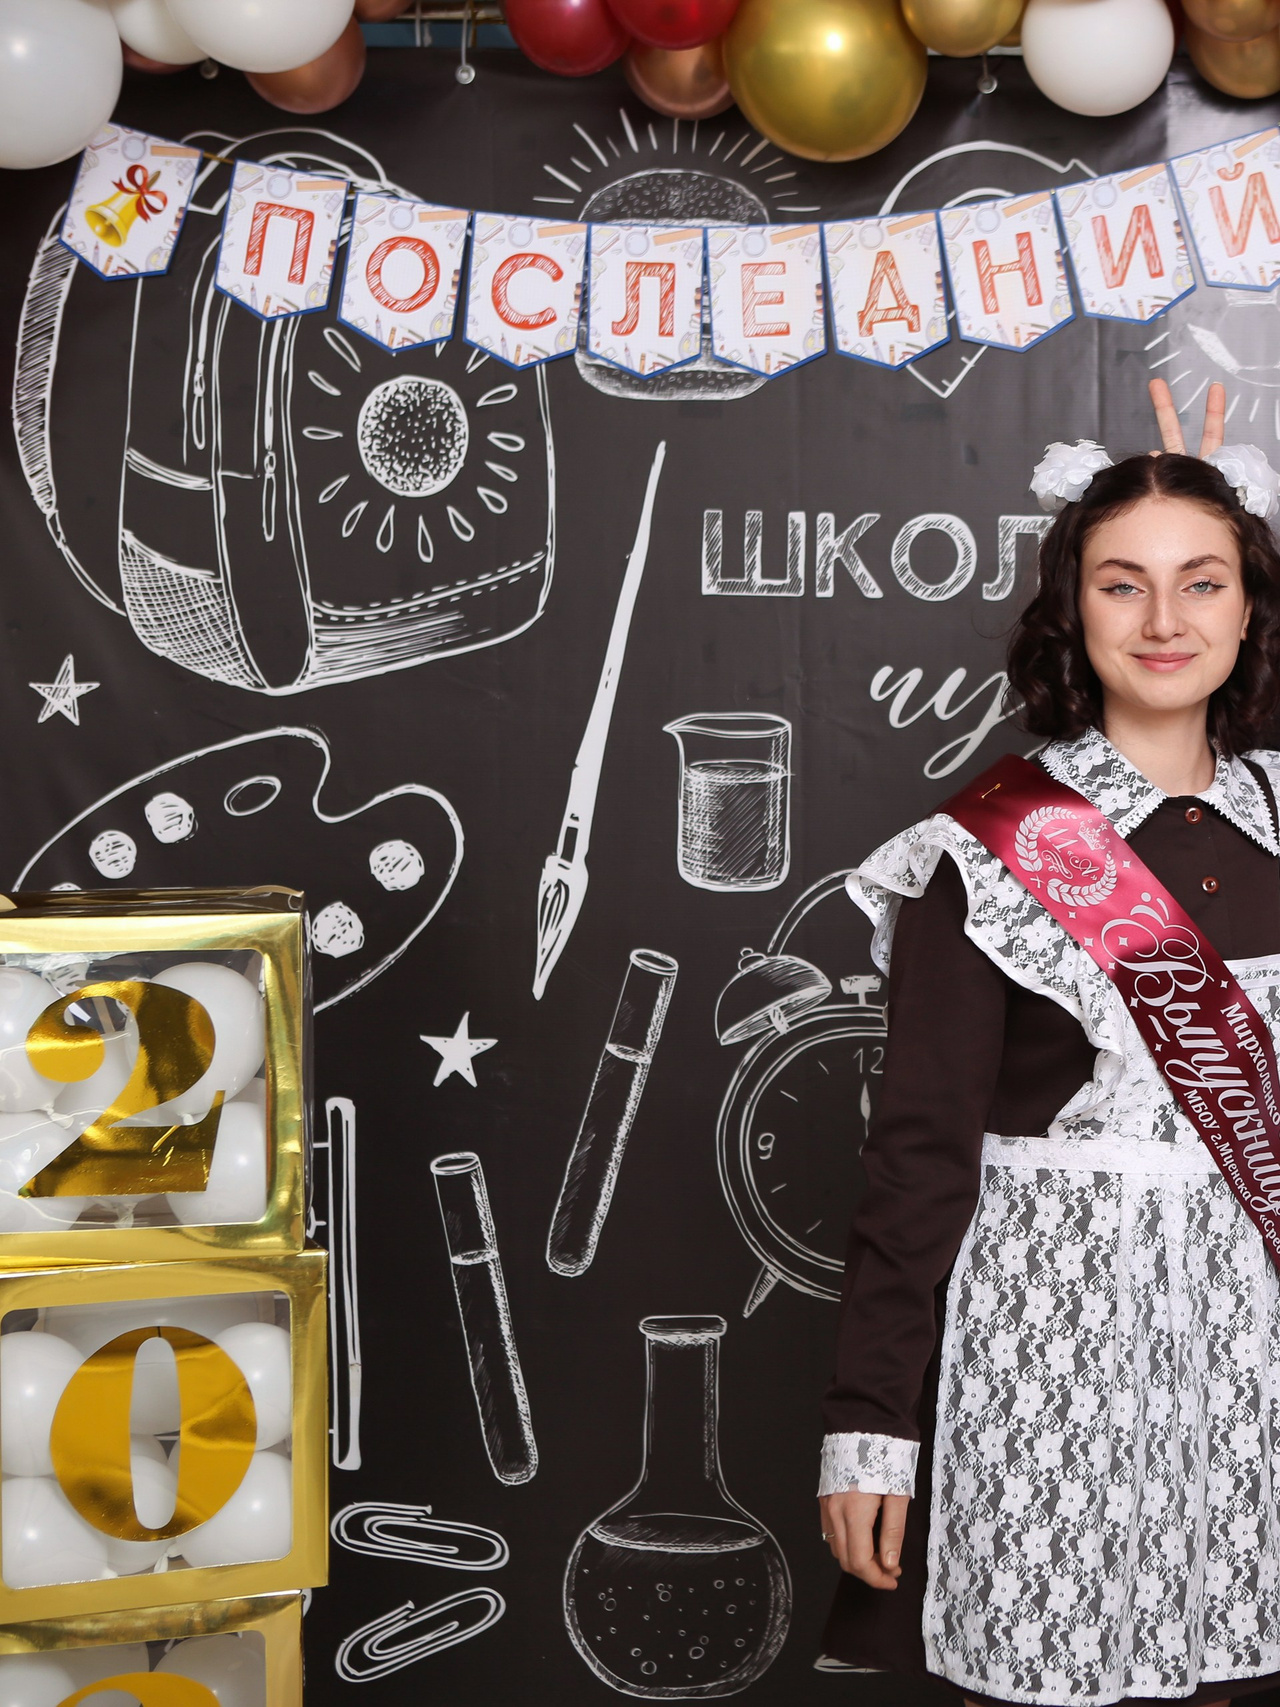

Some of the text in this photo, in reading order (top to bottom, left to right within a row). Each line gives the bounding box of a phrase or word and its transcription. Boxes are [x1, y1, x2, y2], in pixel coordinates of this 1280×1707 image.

[1042, 826, 1078, 853] 11
[853, 1046, 884, 1075] 12
[1220, 1002, 1280, 1126] Мирхоленко
[1183, 1089, 1220, 1130] МБОУ
[757, 1132, 775, 1160] 9
